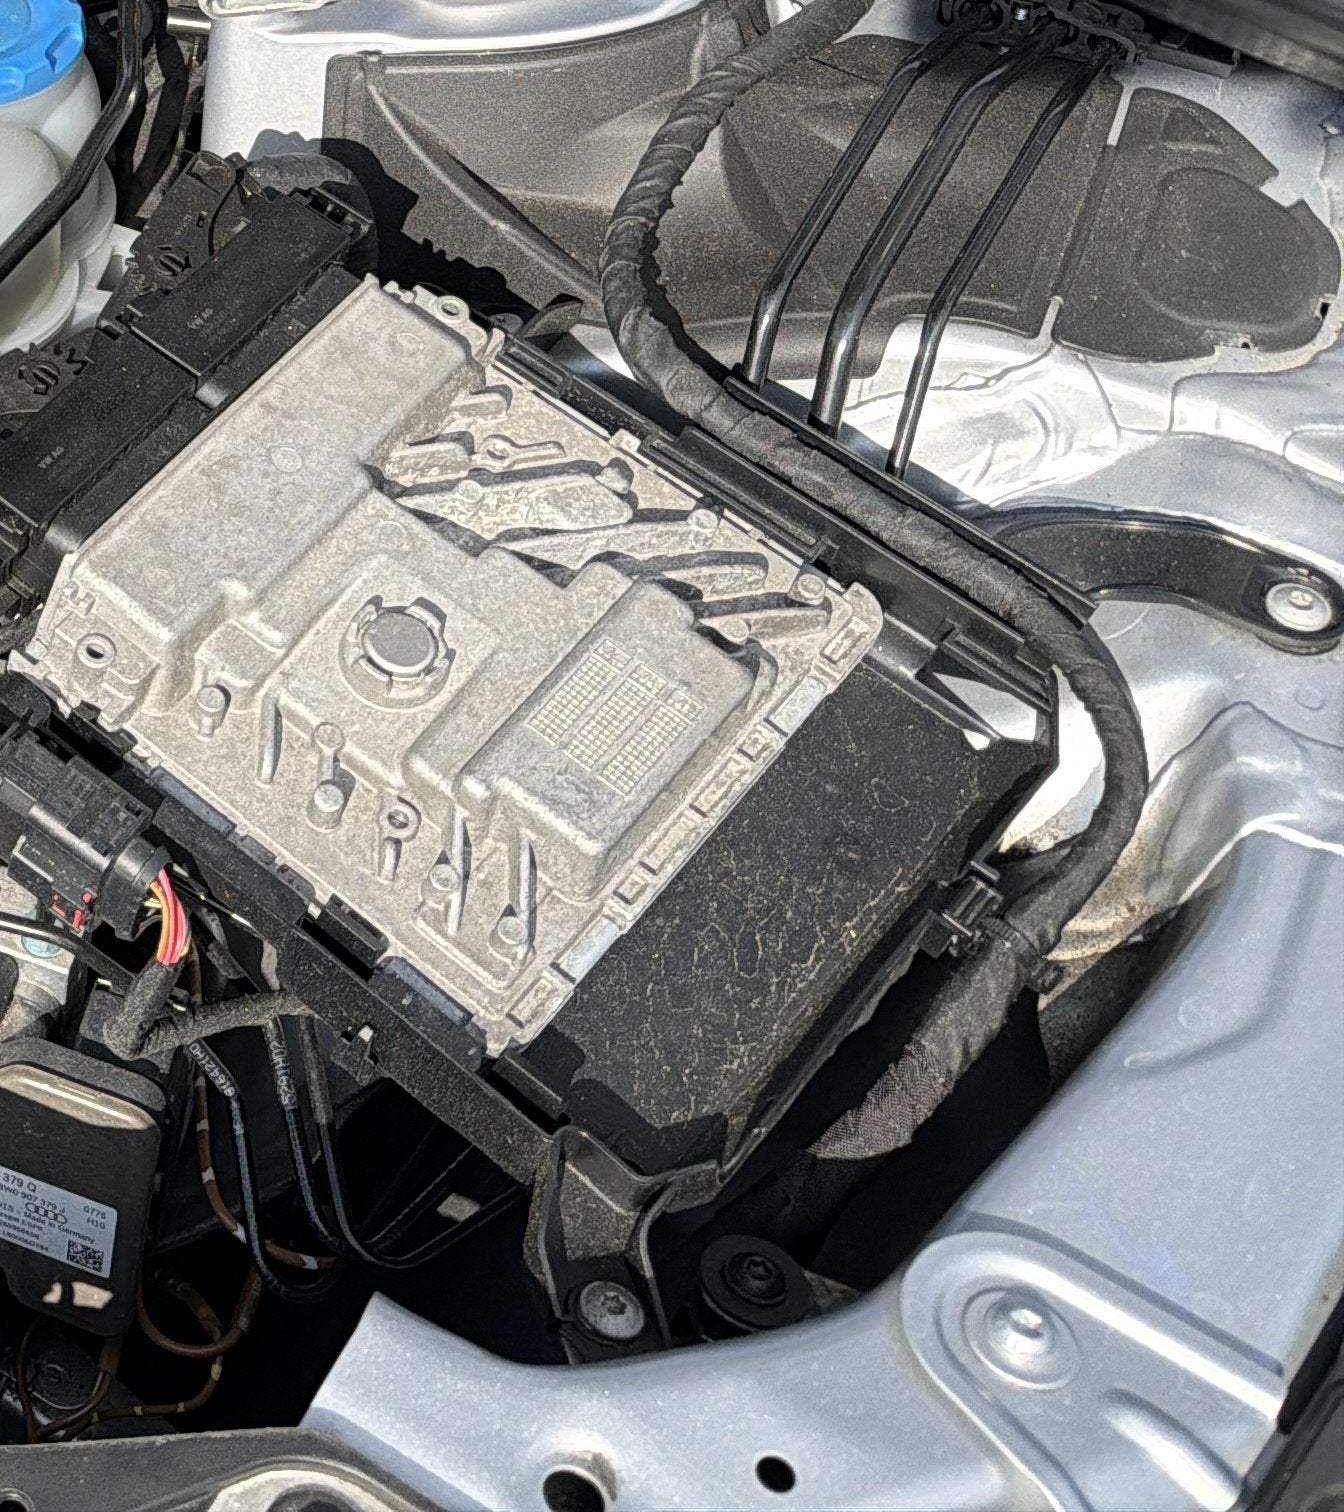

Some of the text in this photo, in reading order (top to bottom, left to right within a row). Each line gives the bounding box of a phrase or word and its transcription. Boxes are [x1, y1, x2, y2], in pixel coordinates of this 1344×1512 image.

[3, 1172, 23, 1187] 379
[26, 1181, 36, 1193] Q
[23, 1211, 46, 1224] Made
[48, 1220, 55, 1228] in
[57, 1224, 95, 1245] Germany
